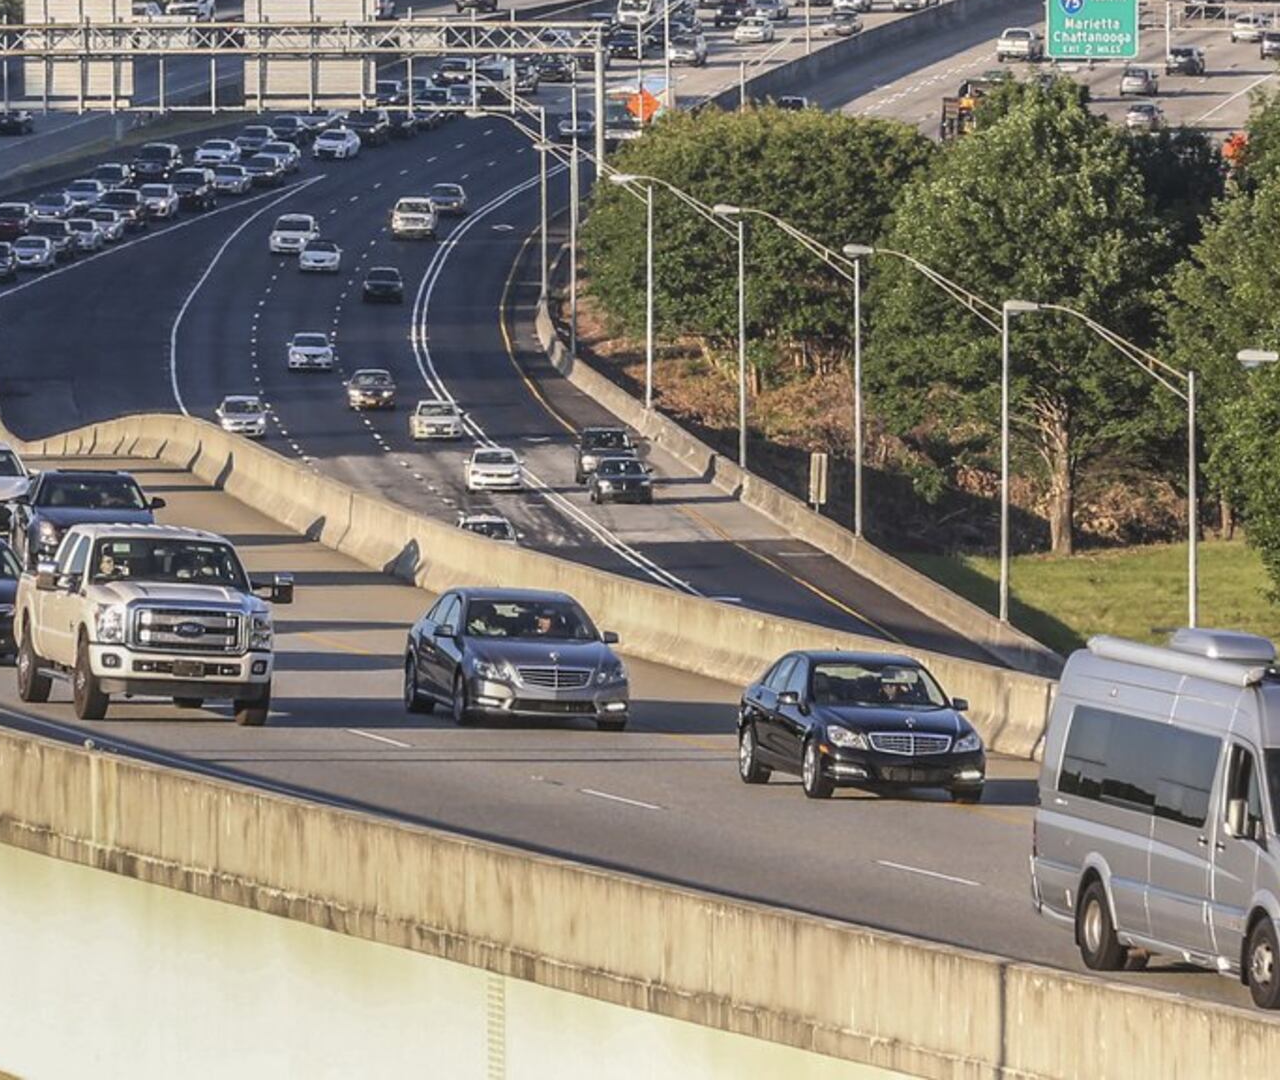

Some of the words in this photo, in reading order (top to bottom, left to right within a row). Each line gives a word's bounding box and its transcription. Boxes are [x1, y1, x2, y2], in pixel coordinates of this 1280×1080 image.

[1064, 18, 1121, 30] Marietta
[1053, 31, 1132, 45] Chattanooga
[1085, 44, 1093, 55] 2
